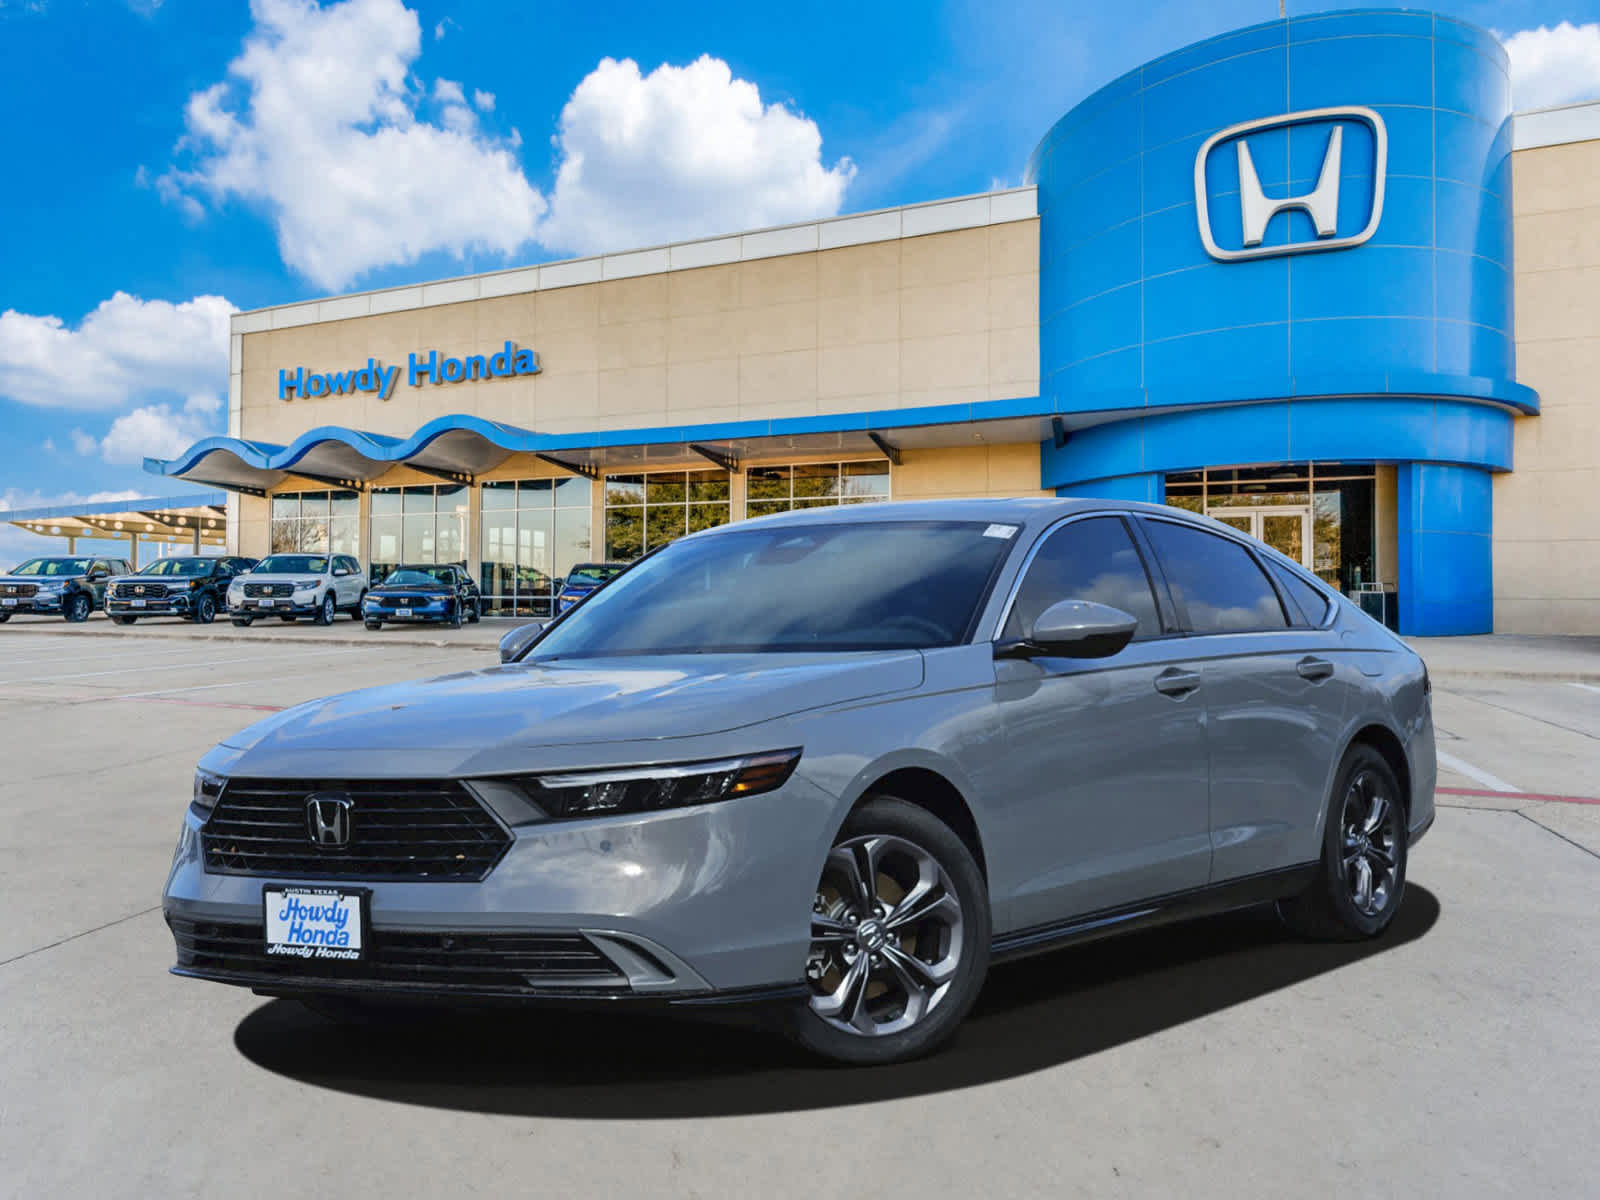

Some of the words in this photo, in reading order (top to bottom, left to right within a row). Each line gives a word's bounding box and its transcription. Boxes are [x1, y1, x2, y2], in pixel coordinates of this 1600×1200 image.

[279, 358, 399, 400] Howdy
[408, 341, 541, 387] Honda
[279, 898, 349, 929] Howdy
[288, 921, 350, 946] Honda
[267, 943, 315, 958] Howdy
[315, 947, 360, 960] Honda
